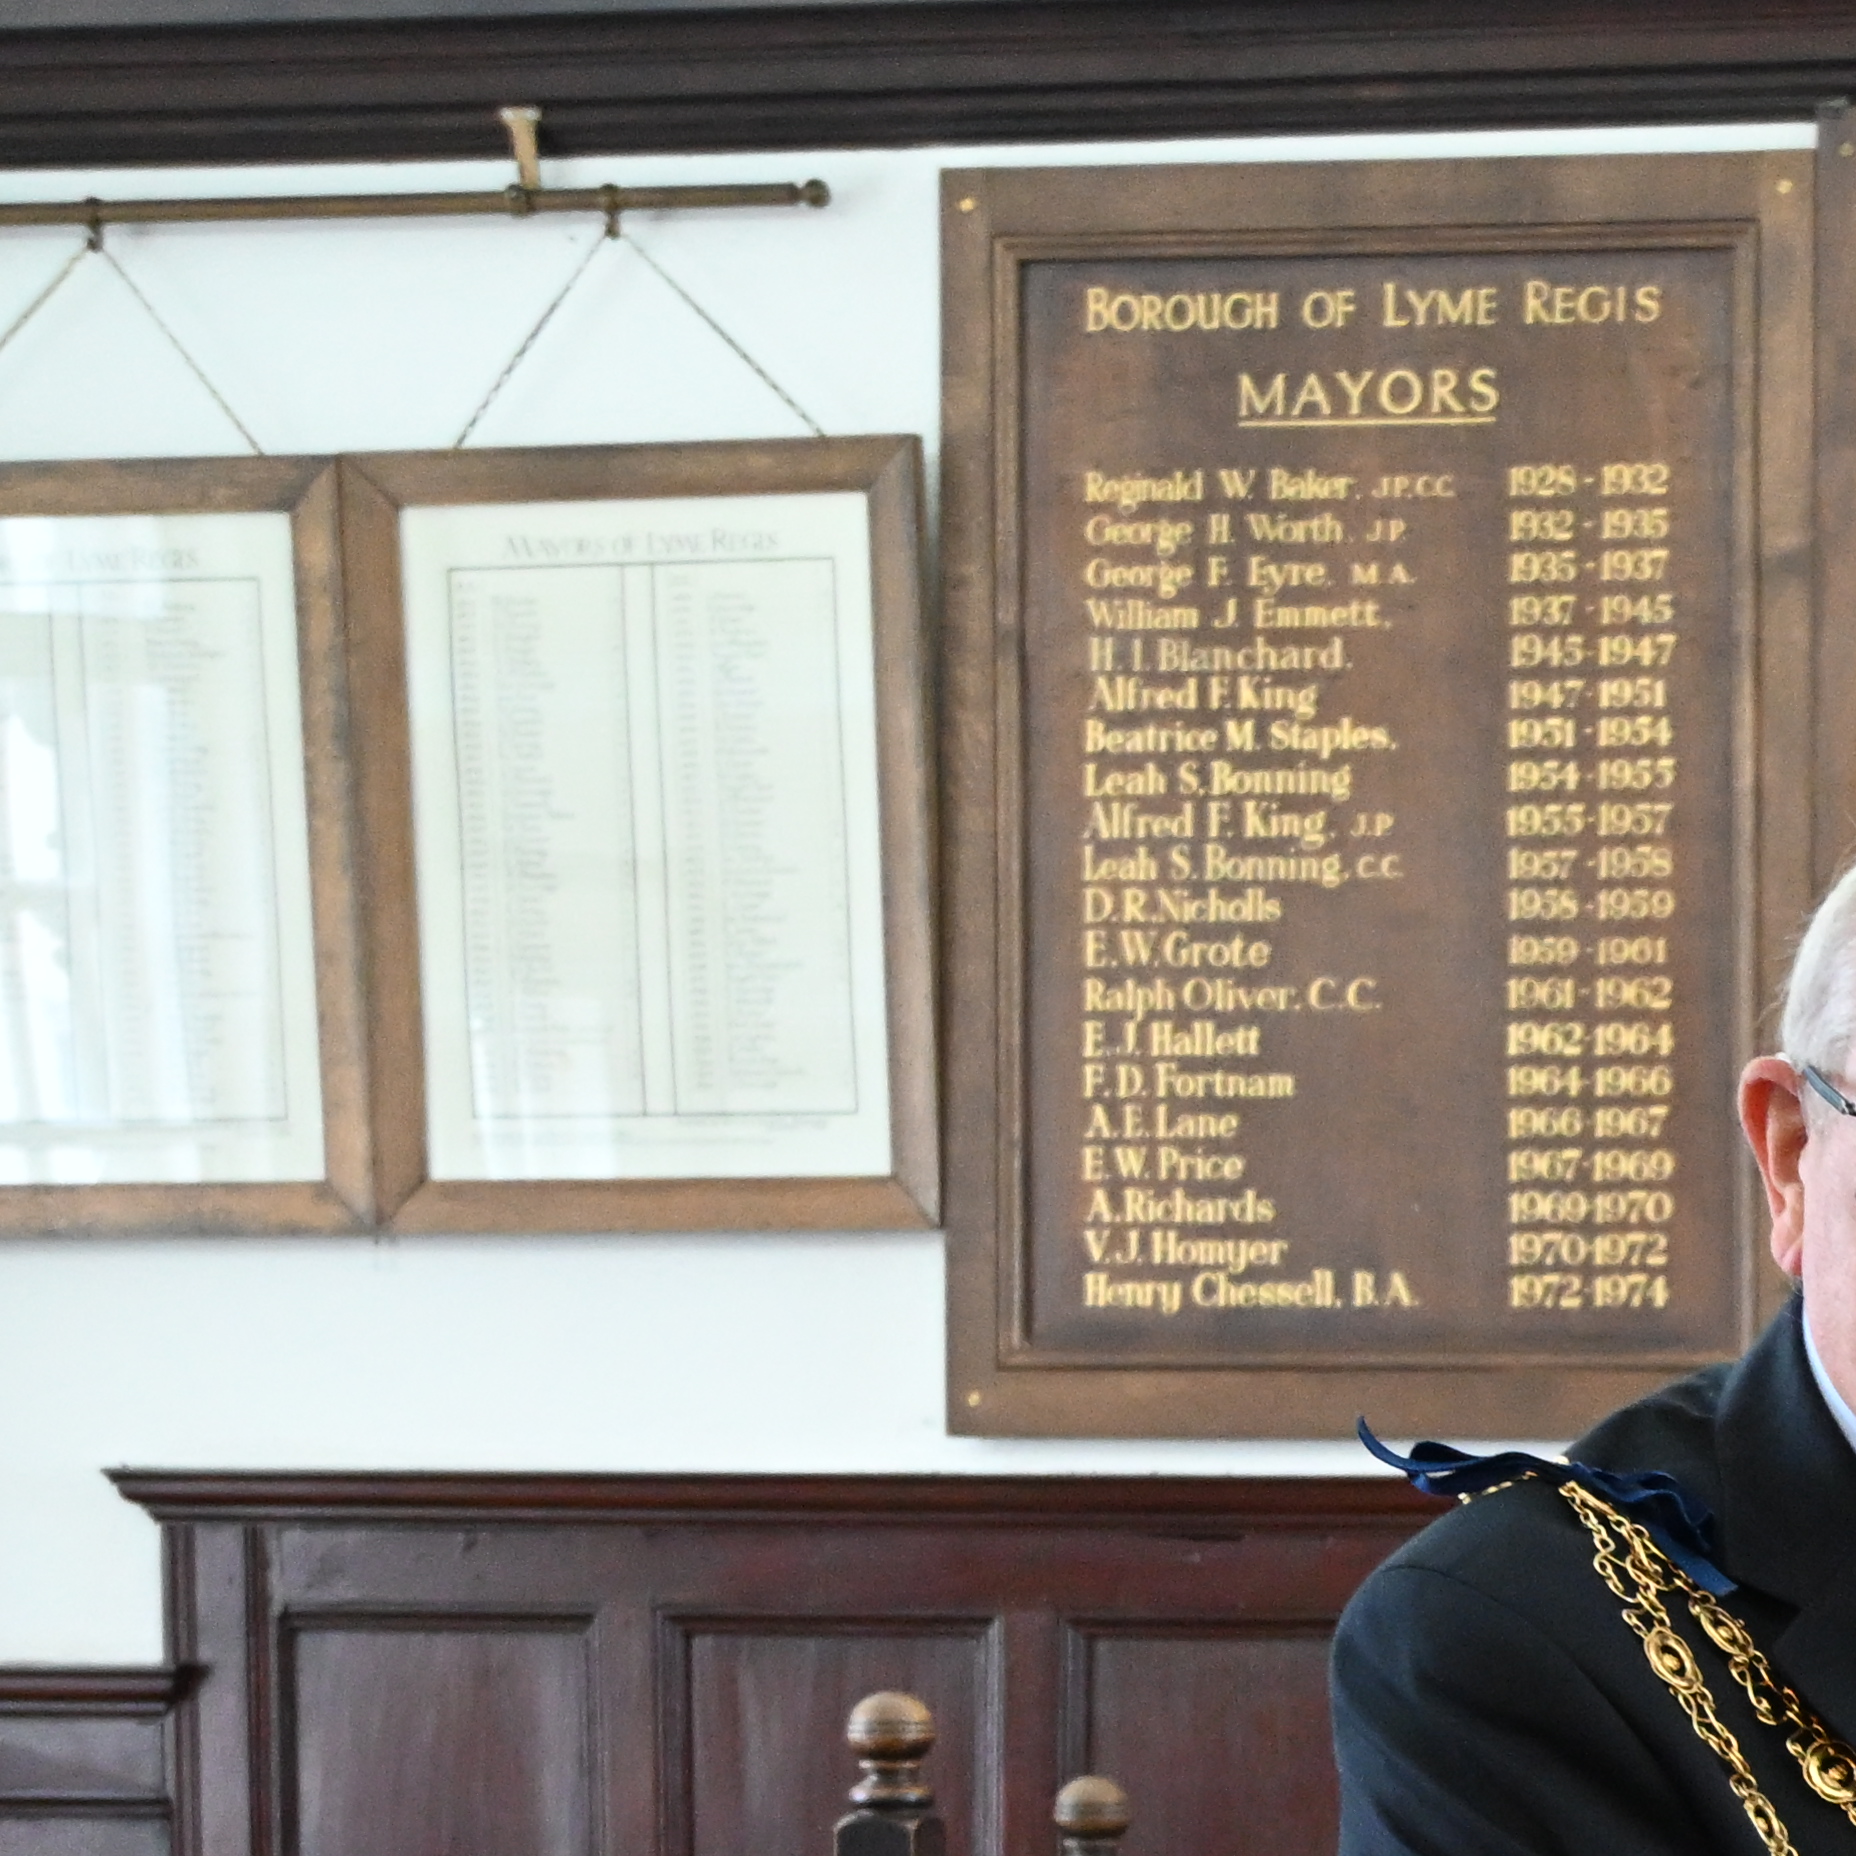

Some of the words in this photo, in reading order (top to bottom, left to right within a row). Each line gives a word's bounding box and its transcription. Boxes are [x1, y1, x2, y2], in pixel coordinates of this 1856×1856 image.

[1085, 287, 1278, 333] BOROUGH
[1303, 289, 1356, 327] OF
[1383, 284, 1496, 328] LYME
[1524, 282, 1660, 326] REGIS
[1238, 367, 1498, 418] MAYORS
[1085, 469, 1203, 516] Reginald
[1084, 514, 1193, 556] George
[1085, 557, 1193, 598] George
[1087, 598, 1198, 630] William
[1088, 676, 1197, 711] Alfred
[1237, 674, 1318, 720] King
[1085, 718, 1217, 753] Beatrice
[1084, 761, 1167, 797] Leah
[1210, 759, 1350, 801] Bonning
[1082, 802, 1193, 839] Alfred
[1082, 844, 1158, 881] Leah
[1083, 977, 1175, 1022] Ralph
[1083, 1271, 1182, 1317] Henry
